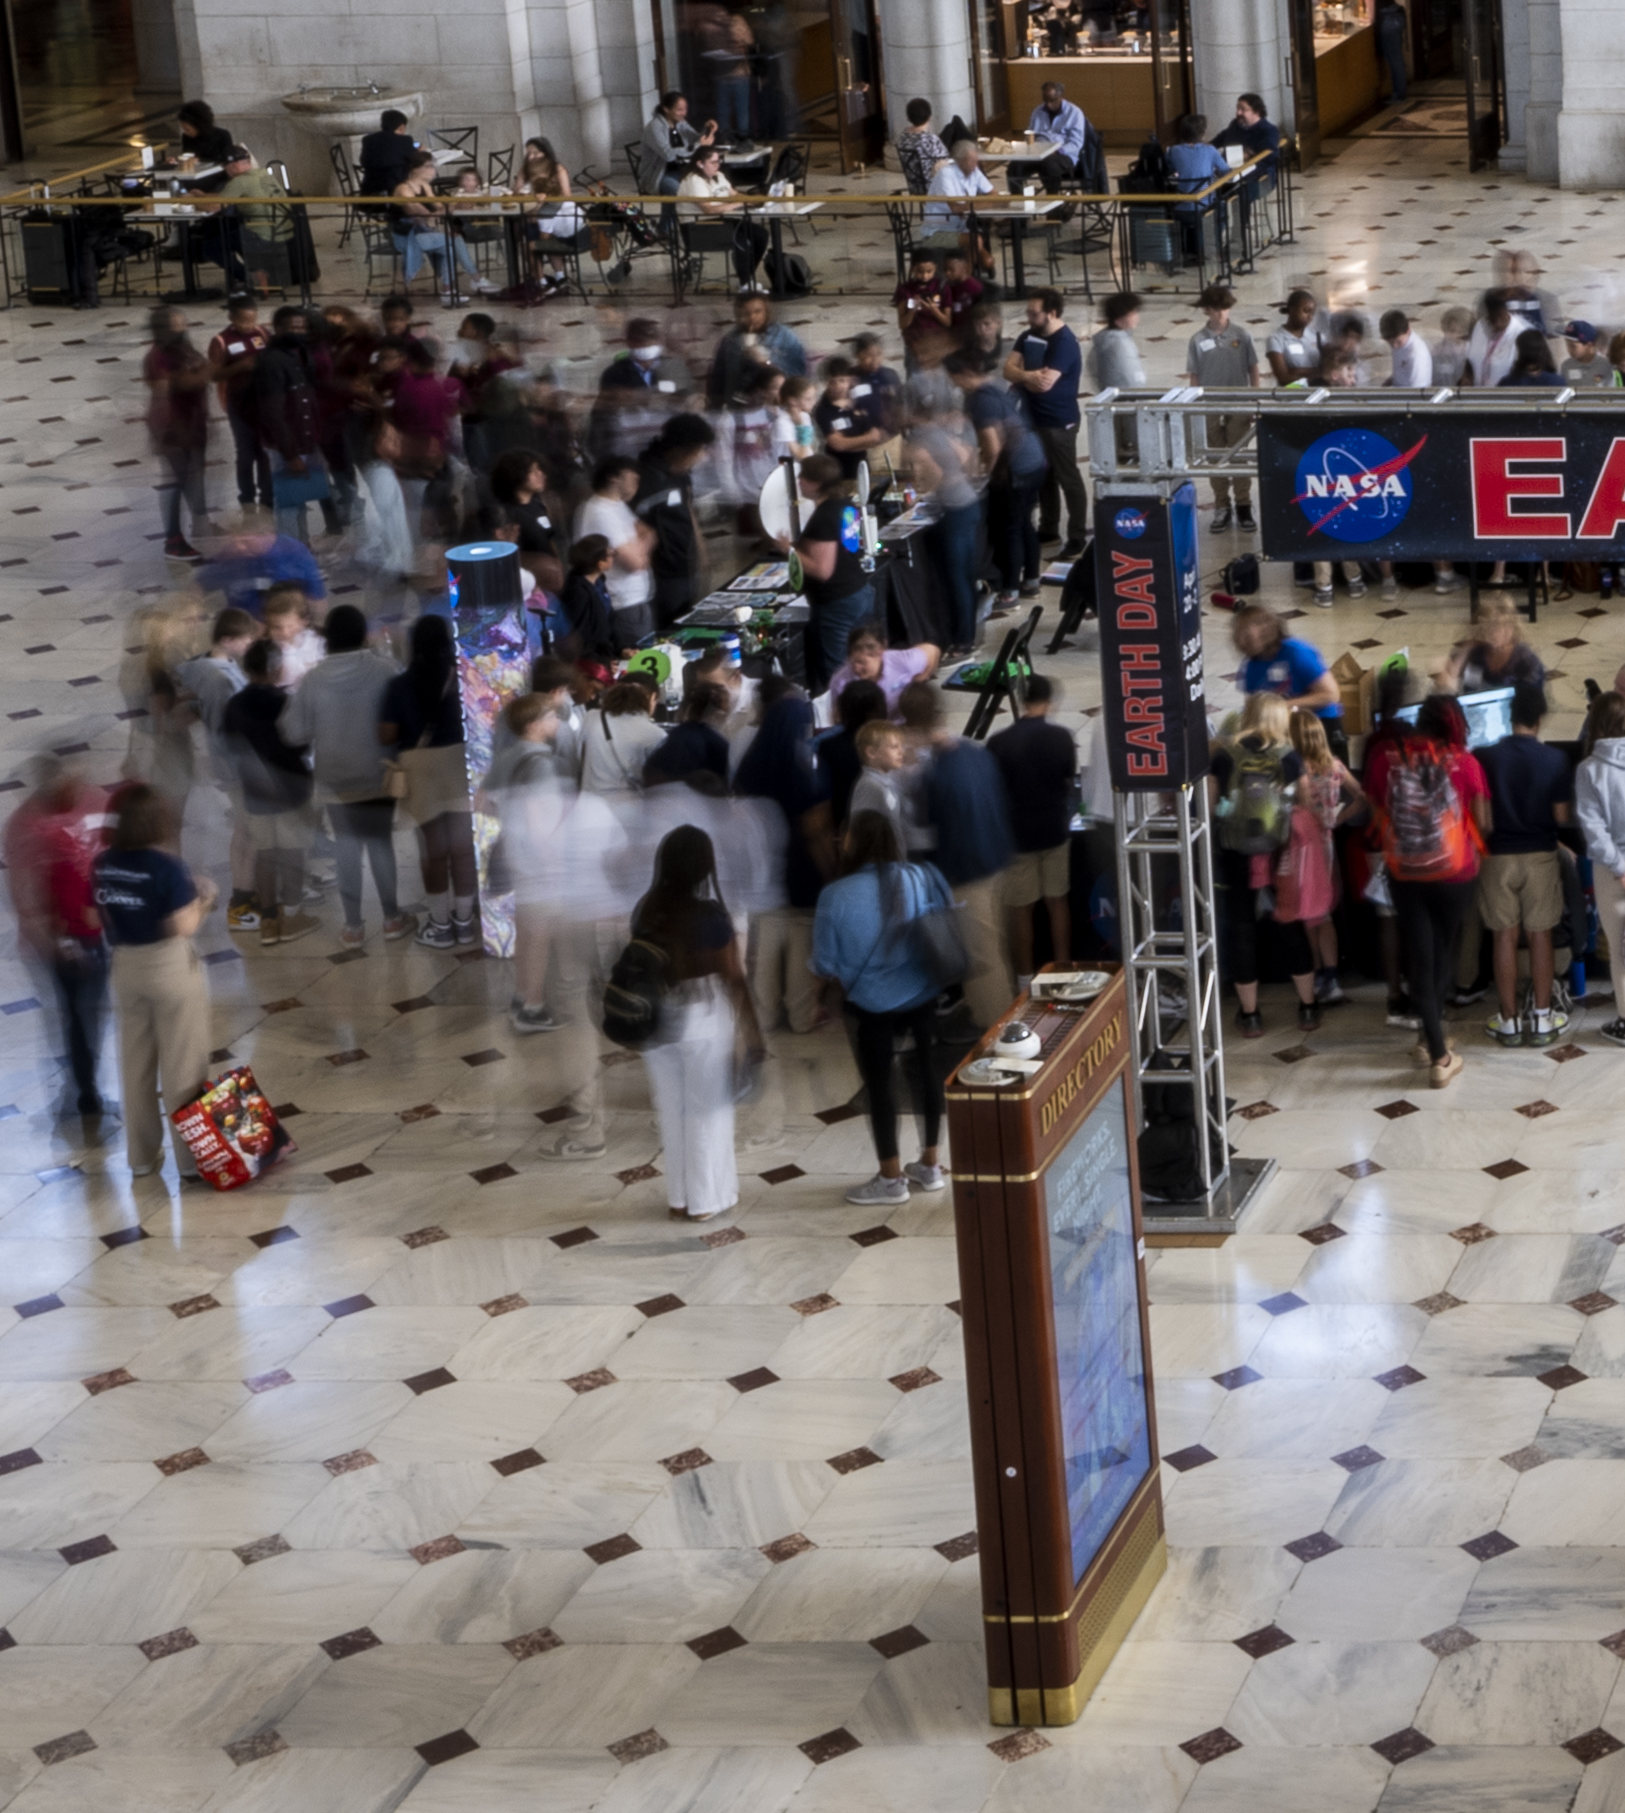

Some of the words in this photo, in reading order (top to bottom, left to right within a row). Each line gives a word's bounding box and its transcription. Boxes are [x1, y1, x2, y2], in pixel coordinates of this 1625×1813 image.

[1112, 549, 1158, 629] DAY
[640, 656, 661, 684] 3
[1116, 639, 1168, 778] EARTH
[1040, 1010, 1124, 1137] DIRECTORY
